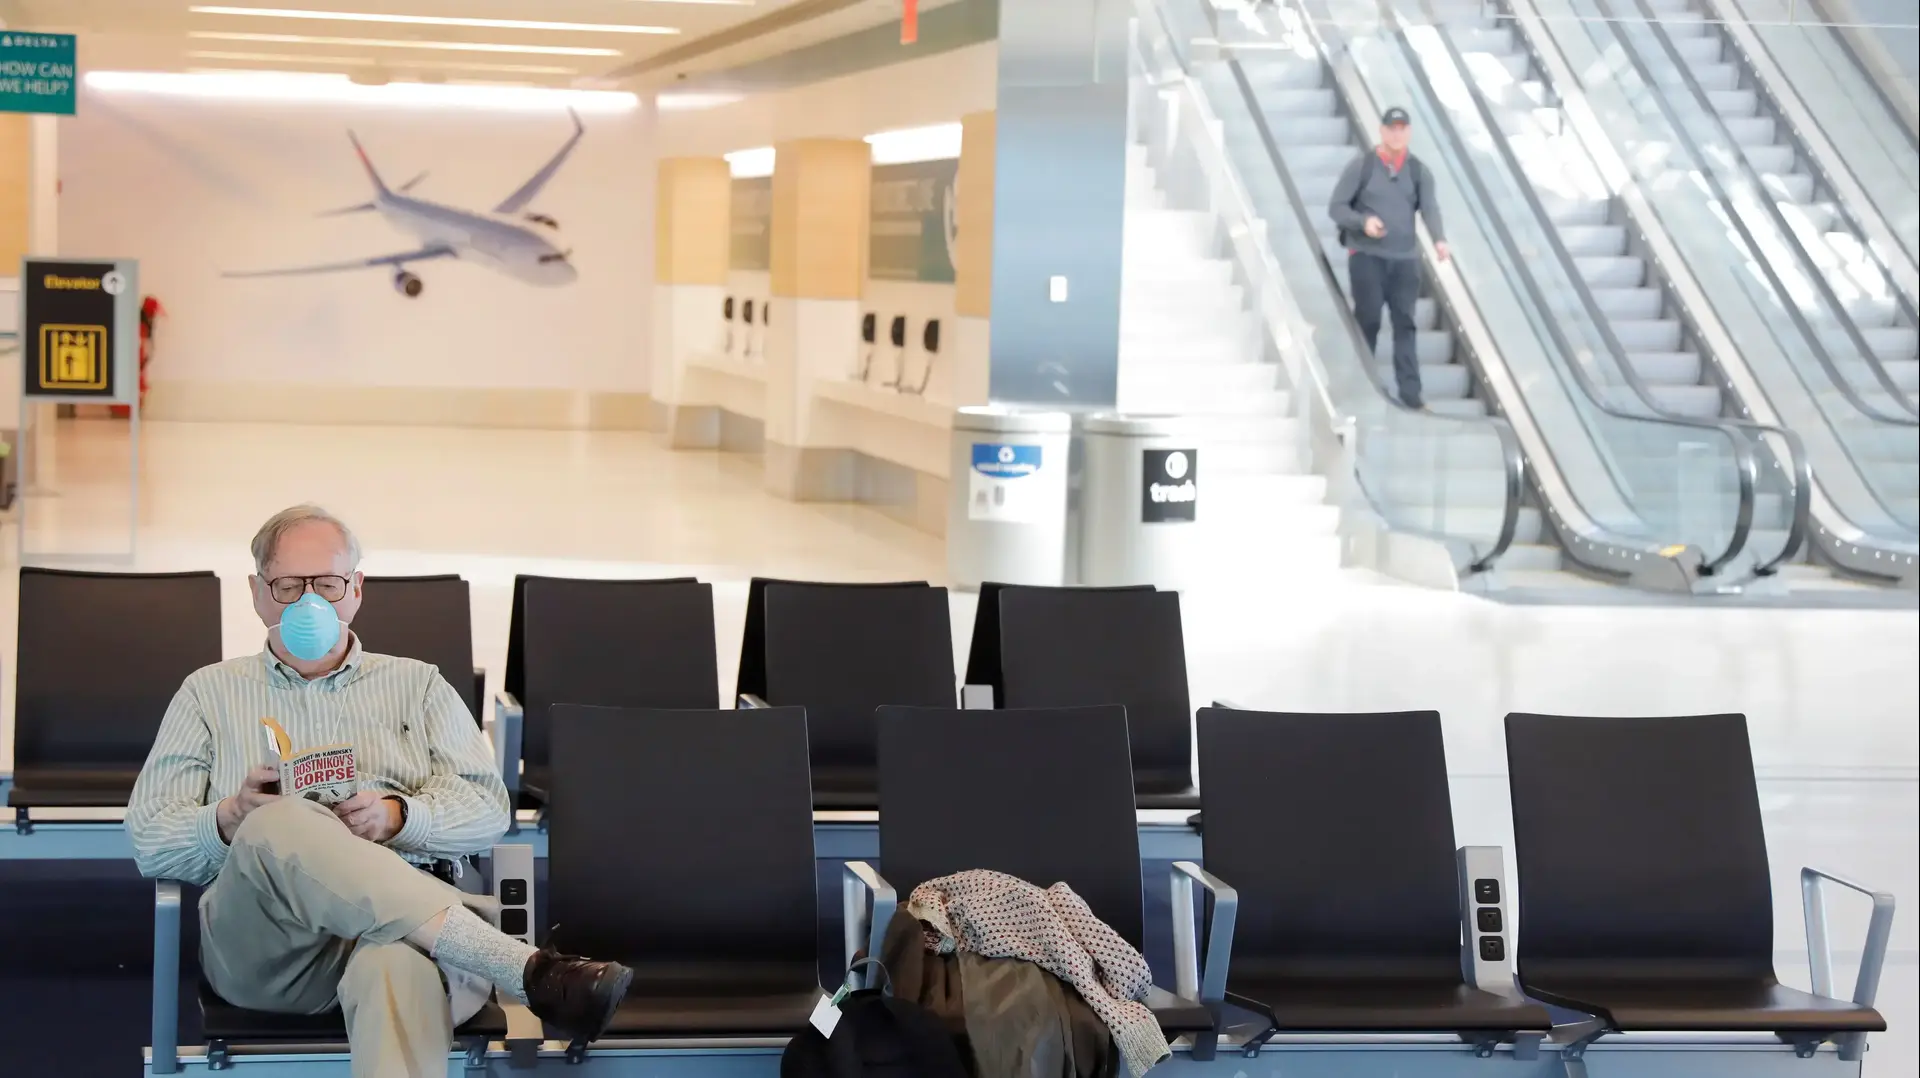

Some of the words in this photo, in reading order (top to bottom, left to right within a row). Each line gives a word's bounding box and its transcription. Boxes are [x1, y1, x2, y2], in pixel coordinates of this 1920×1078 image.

[0, 61, 37, 76] HOW
[38, 62, 73, 78] CAN
[0, 78, 22, 93] WE
[24, 79, 69, 95] HELP?
[44, 274, 100, 290] Elevator
[293, 753, 313, 766] STUART
[322, 748, 353, 757] KAMINSKY
[293, 753, 354, 778] ROSTNIKOV'S
[294, 766, 355, 790] CORPSE
